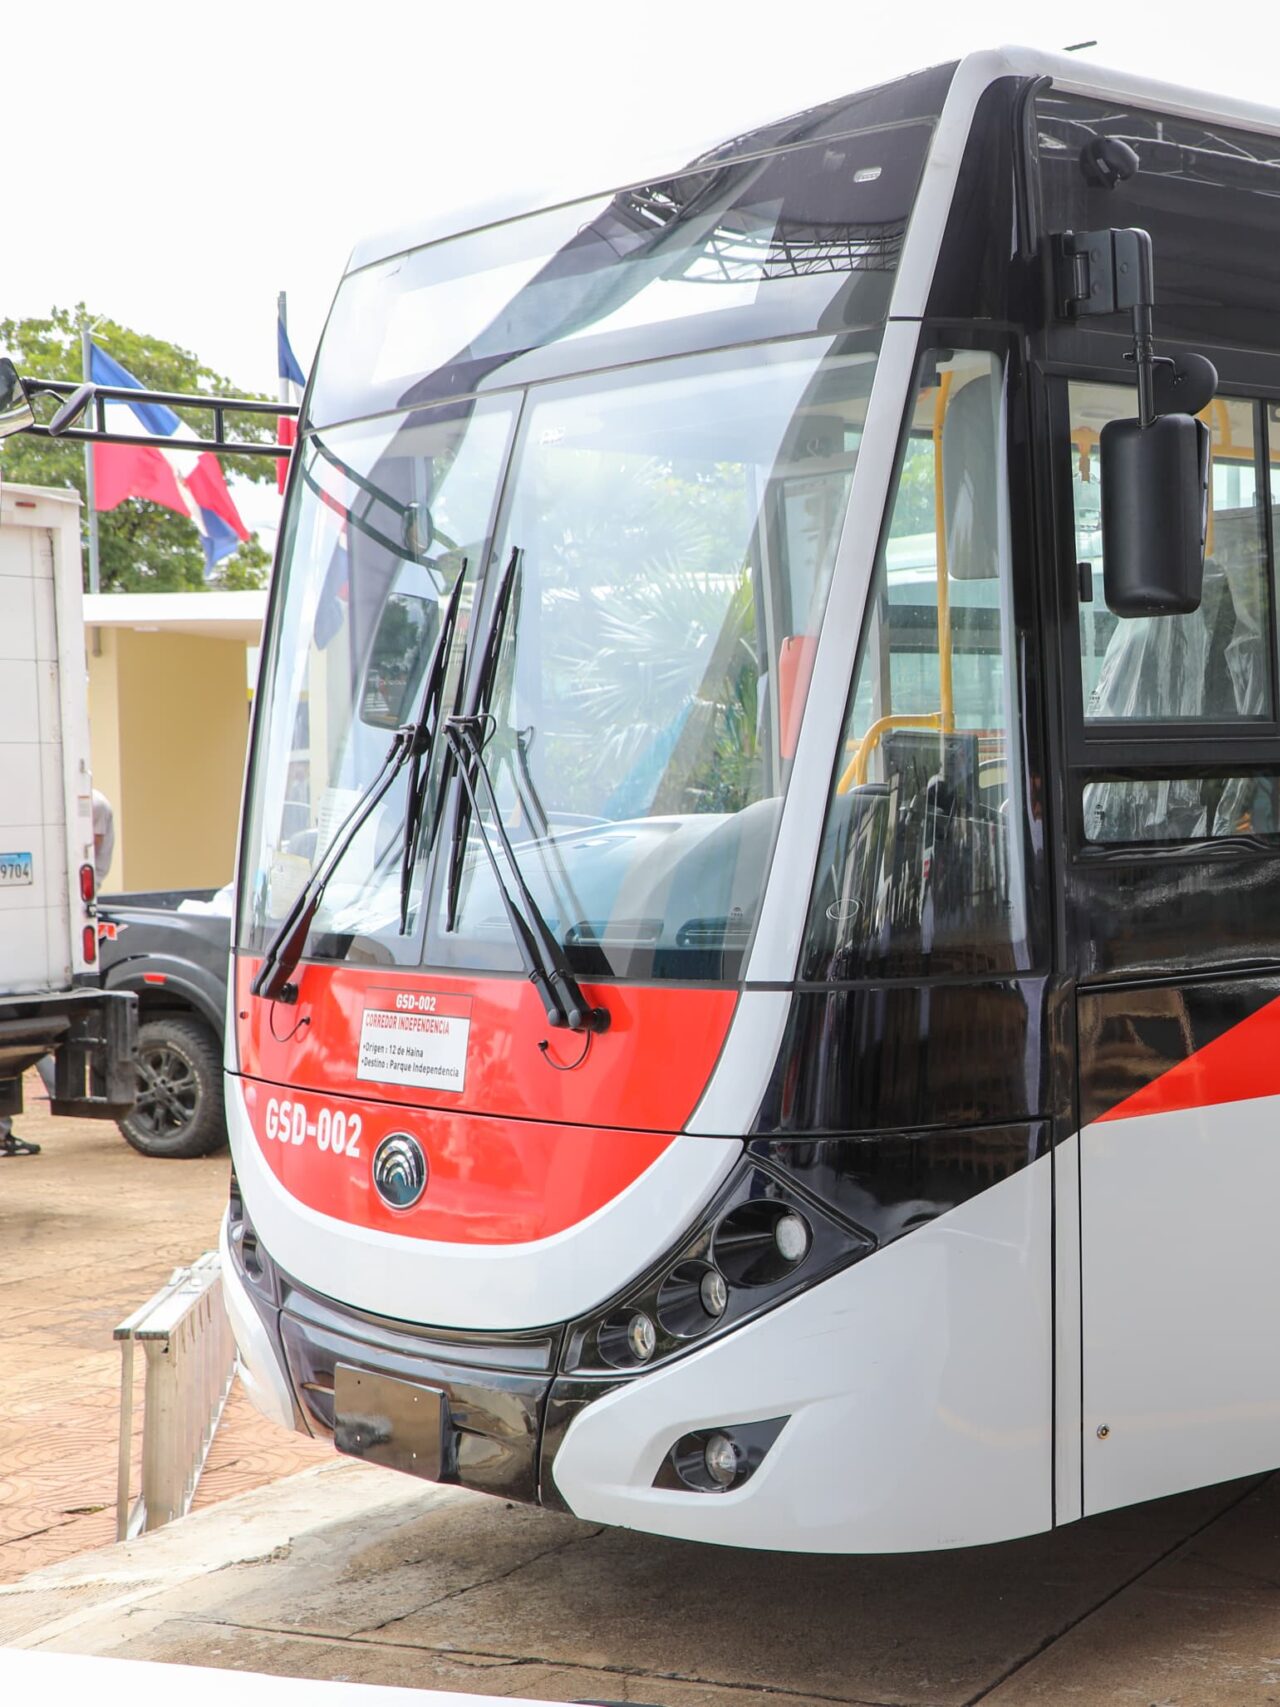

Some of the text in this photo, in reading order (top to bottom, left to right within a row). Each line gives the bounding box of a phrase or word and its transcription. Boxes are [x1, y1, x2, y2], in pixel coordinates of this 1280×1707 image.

[0, 863, 29, 879] 9704
[396, 993, 436, 1011] GSD-002
[365, 1013, 449, 1034] CORREDOR INDEPENDENCIA
[389, 1045, 396, 1055] 12
[397, 1046, 404, 1055] de
[406, 1046, 424, 1058] Haina
[364, 1057, 385, 1069] Destino
[389, 1060, 412, 1073] Parque
[412, 1062, 460, 1078] Independencia
[265, 1098, 362, 1158] GSD-002
